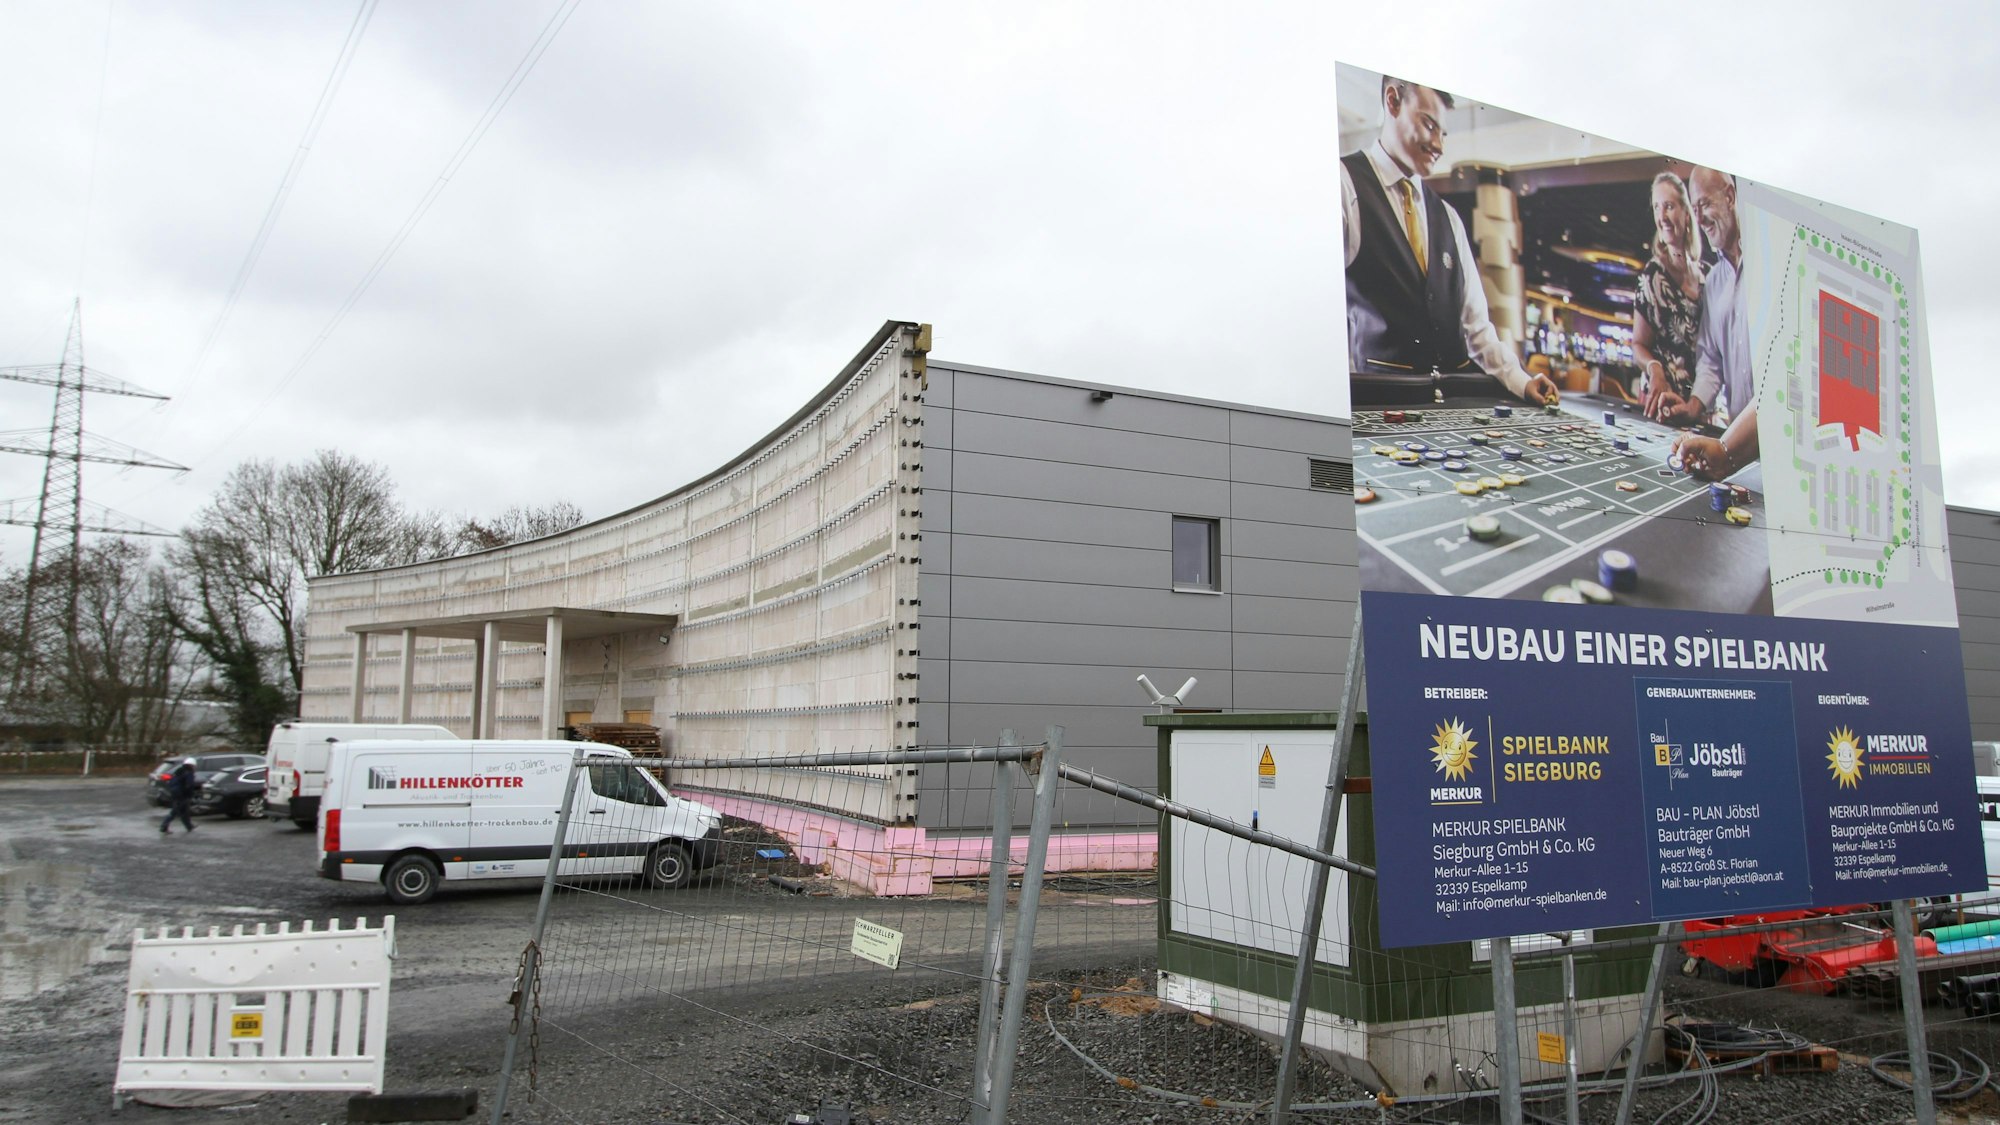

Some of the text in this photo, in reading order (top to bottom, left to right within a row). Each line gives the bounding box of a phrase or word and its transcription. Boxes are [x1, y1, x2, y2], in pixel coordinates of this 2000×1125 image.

[1420, 623, 1828, 672] NEUBAU EINER SPIELBANK
[1424, 687, 1488, 700] BETREIBER:
[1646, 687, 1756, 700] GENERALUNTERNEHMER:
[1818, 693, 1870, 706] EIGENTÜMER:
[1650, 732, 1664, 743] Bau
[1866, 735, 1928, 752] MERKUR
[1502, 736, 1610, 756] SPIELBANK
[1660, 749, 1668, 762] B
[1690, 743, 1742, 766] Jöbstl
[520, 759, 546, 770] Jahre
[1504, 762, 1602, 782] SIEGBURG
[1869, 762, 1931, 776] IMMOBILIEN
[1712, 768, 1743, 778] Bauträger
[400, 774, 524, 789] HILLENKÖTTER
[1430, 787, 1482, 800] MERKUR
[1656, 808, 1680, 822] BAU
[1692, 806, 1722, 820] PLAN
[1726, 804, 1760, 819] Jöbstl
[1829, 801, 1939, 818] MERKUR Immobilien und
[398, 818, 553, 828] www.hillenkoetter-trockenbau.de
[1432, 817, 1566, 838] MERKUR SPIELBANK
[1831, 818, 1955, 839] Bauprojekte GmbH & Co. KG
[1658, 825, 1750, 844] Bauträger GmbH
[1433, 837, 1596, 863] Siegburg GmbH & Co. KG
[1660, 846, 1712, 859] Neuer Weg 6
[1832, 839, 1896, 852] Merkur-Allee 1-15
[1660, 858, 1758, 874] A-8522 Groß St. Florian
[1834, 854, 1896, 866] 32339 Espelkamp
[1434, 862, 1528, 878] Merkur-Allee 1-15
[1835, 862, 1948, 880] Mail: info@merkur-immobilien.de
[1436, 879, 1528, 896] 32339 Espelkamp
[1662, 871, 1784, 889] Mail: bau-plan.joebstl@aon.at
[1436, 888, 1607, 913] Mail: info@merkur-spielbanken.de
[856, 920, 895, 940] SCHWARZFELLER
